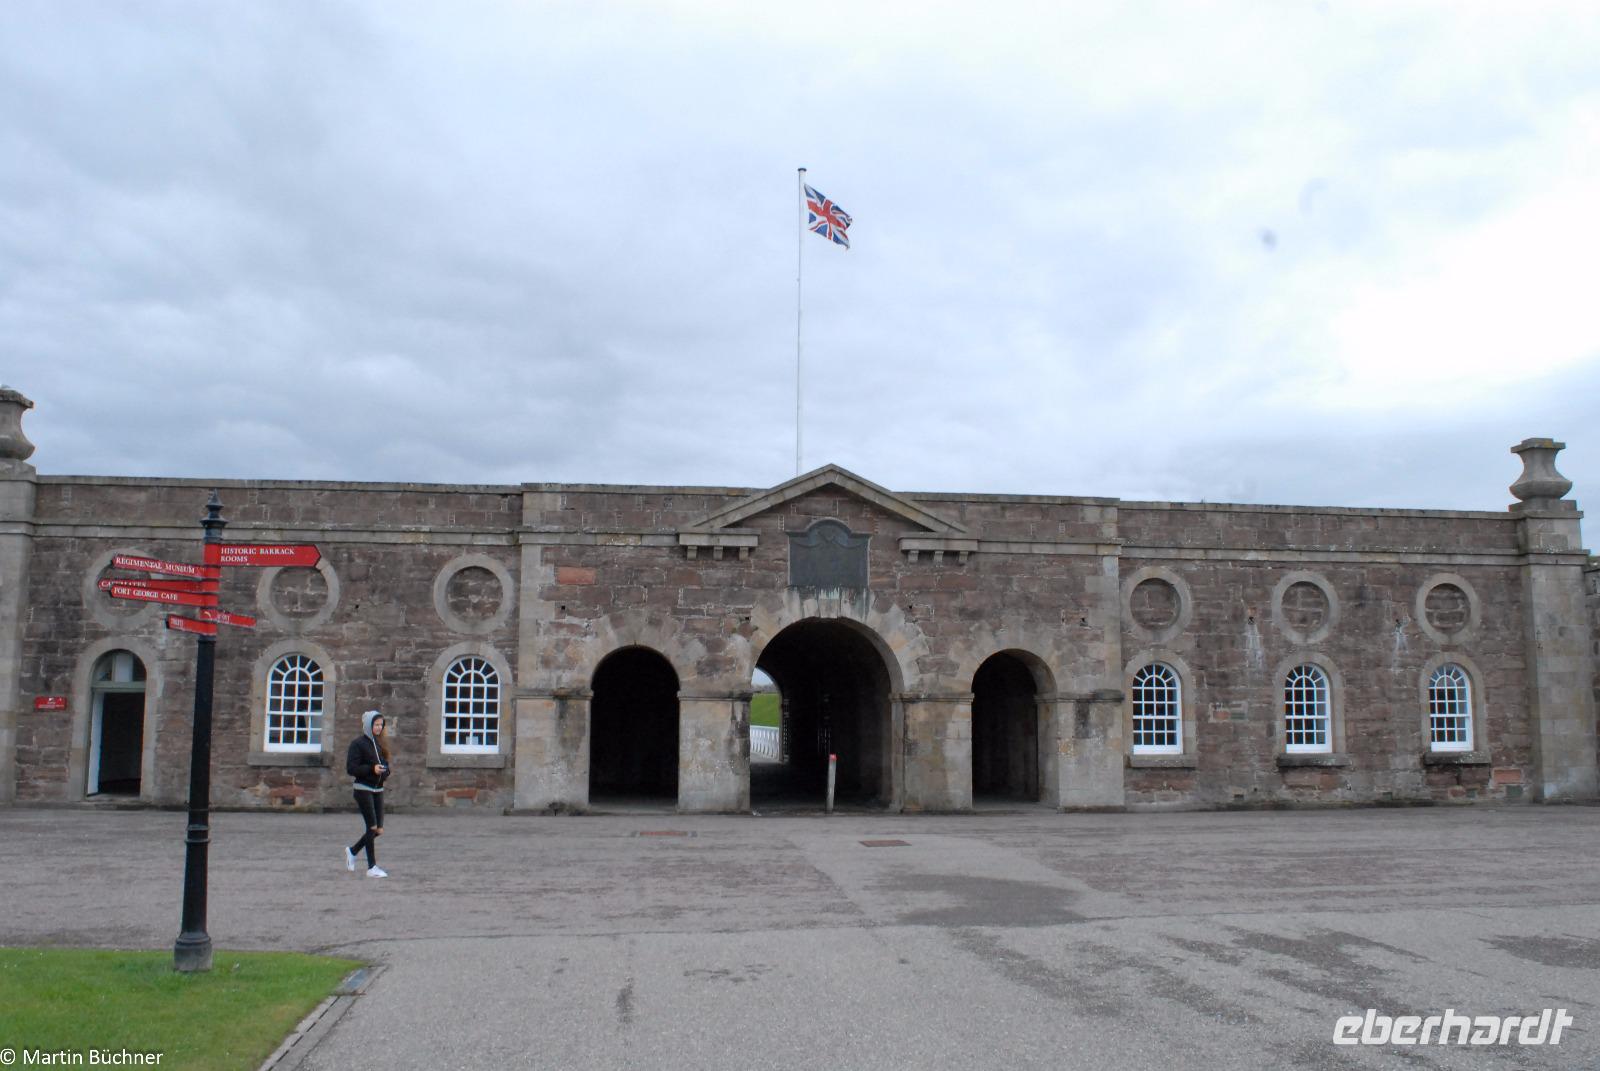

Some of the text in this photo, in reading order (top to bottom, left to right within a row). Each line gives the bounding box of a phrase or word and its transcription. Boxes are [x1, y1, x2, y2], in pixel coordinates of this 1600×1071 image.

[220, 547, 295, 555] HISTORIC BARRACK
[220, 555, 248, 563] ROOMS
[115, 557, 195, 575] REGIMENTAL MUSEUM
[114, 587, 178, 602] FORT GEORGE CAFE
